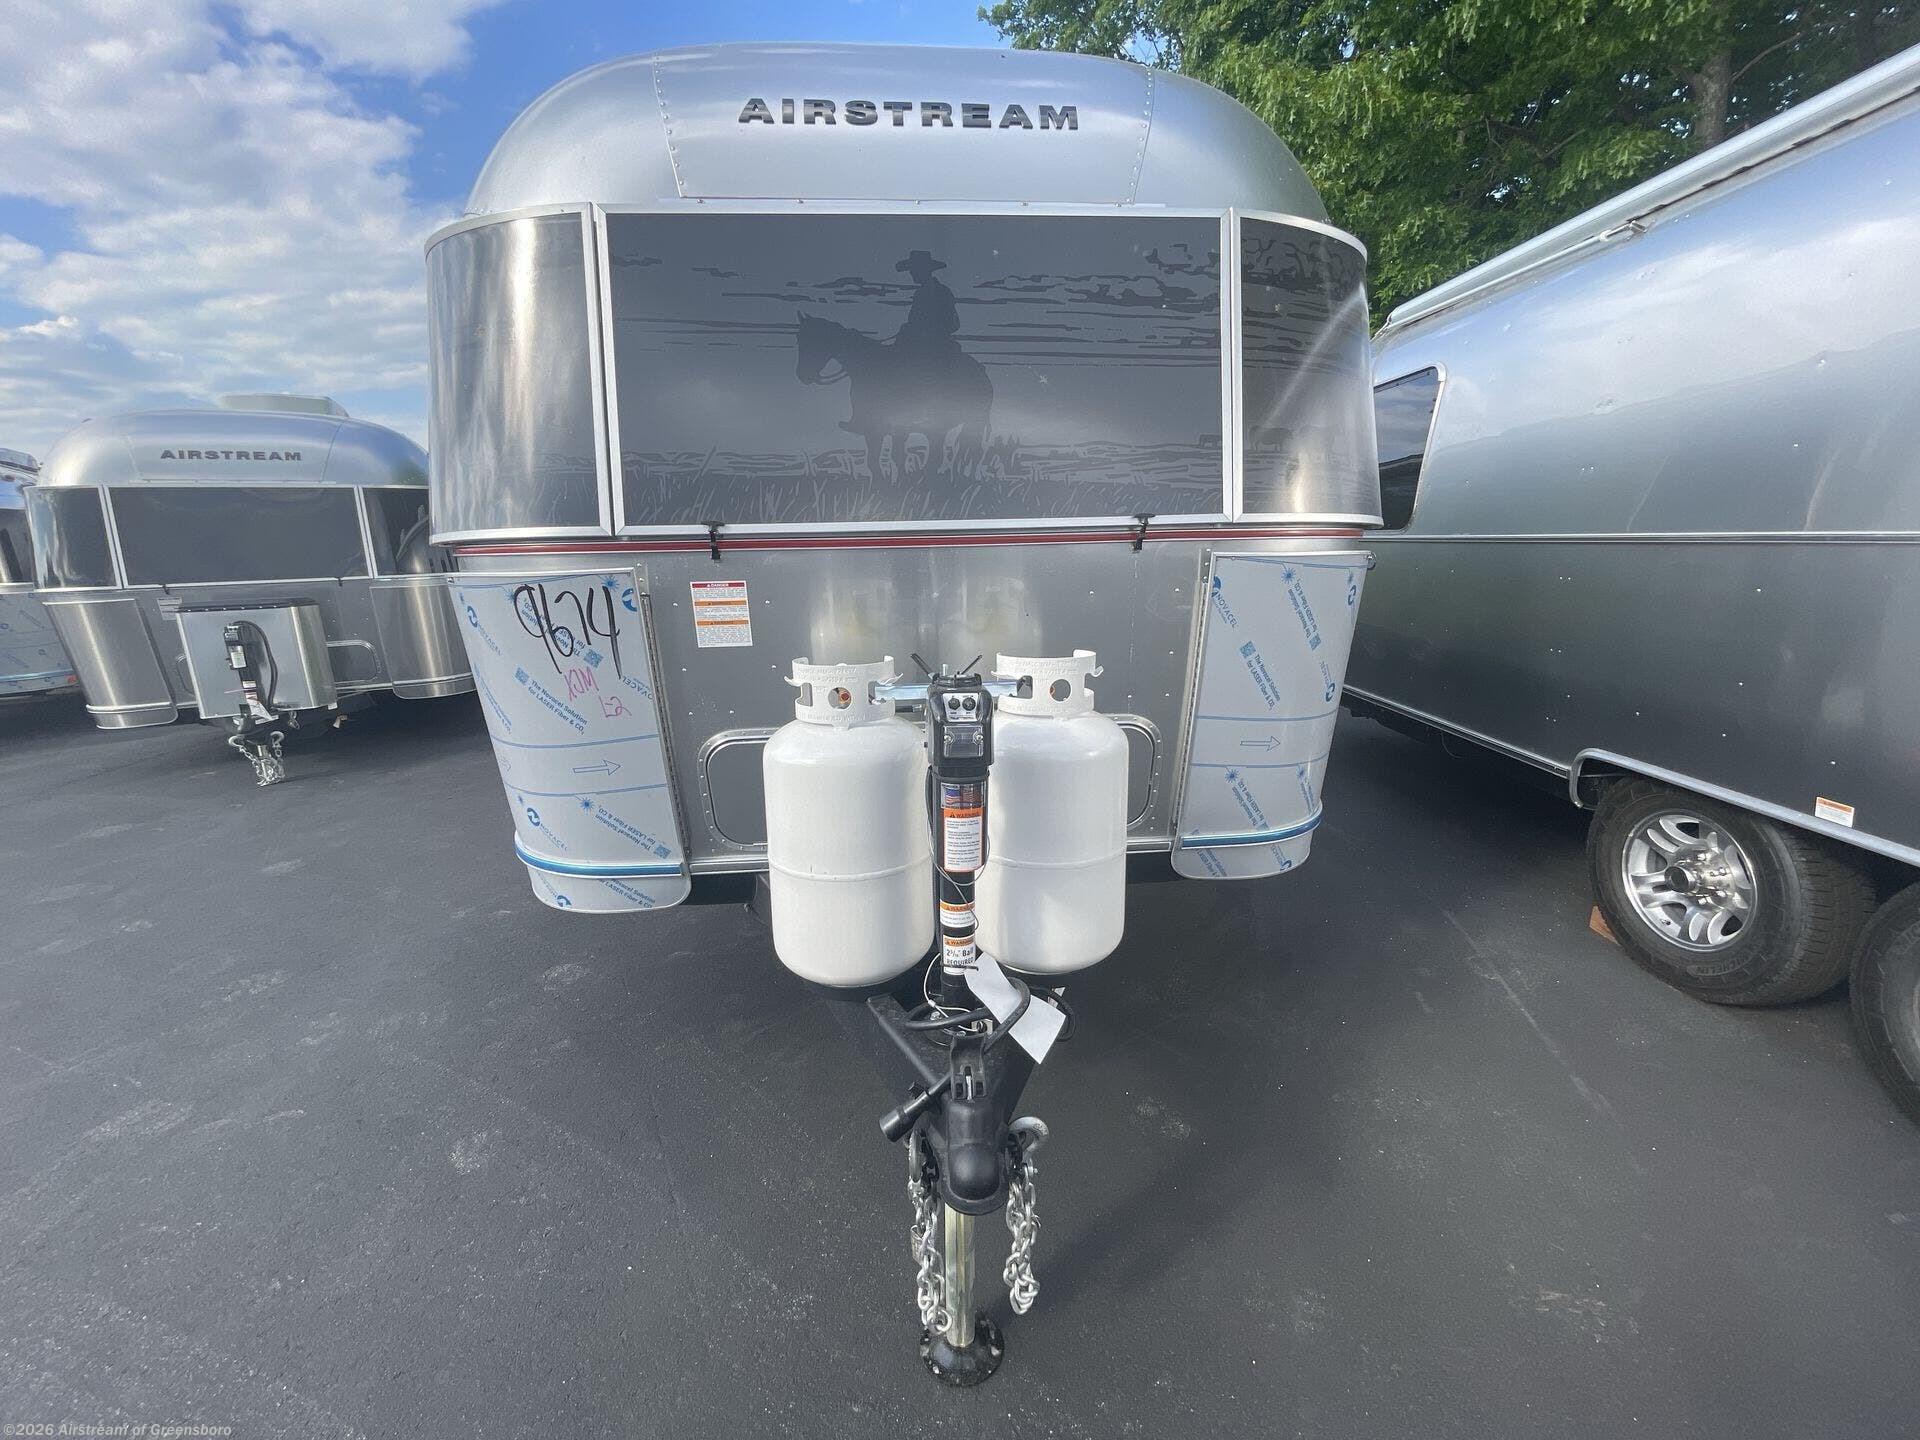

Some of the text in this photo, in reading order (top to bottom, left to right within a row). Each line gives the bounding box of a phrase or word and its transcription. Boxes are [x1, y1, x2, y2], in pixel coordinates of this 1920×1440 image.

[738, 98, 1079, 130] AIRSTREAM
[160, 449, 302, 461] AIRSTREAM
[1215, 592, 1238, 629] NOVACEL
[528, 686, 537, 696] for
[536, 693, 555, 711] LASER
[554, 708, 569, 721] Fiber
[531, 680, 588, 726] The Novacel Solution
[622, 675, 654, 701] OVACEL
